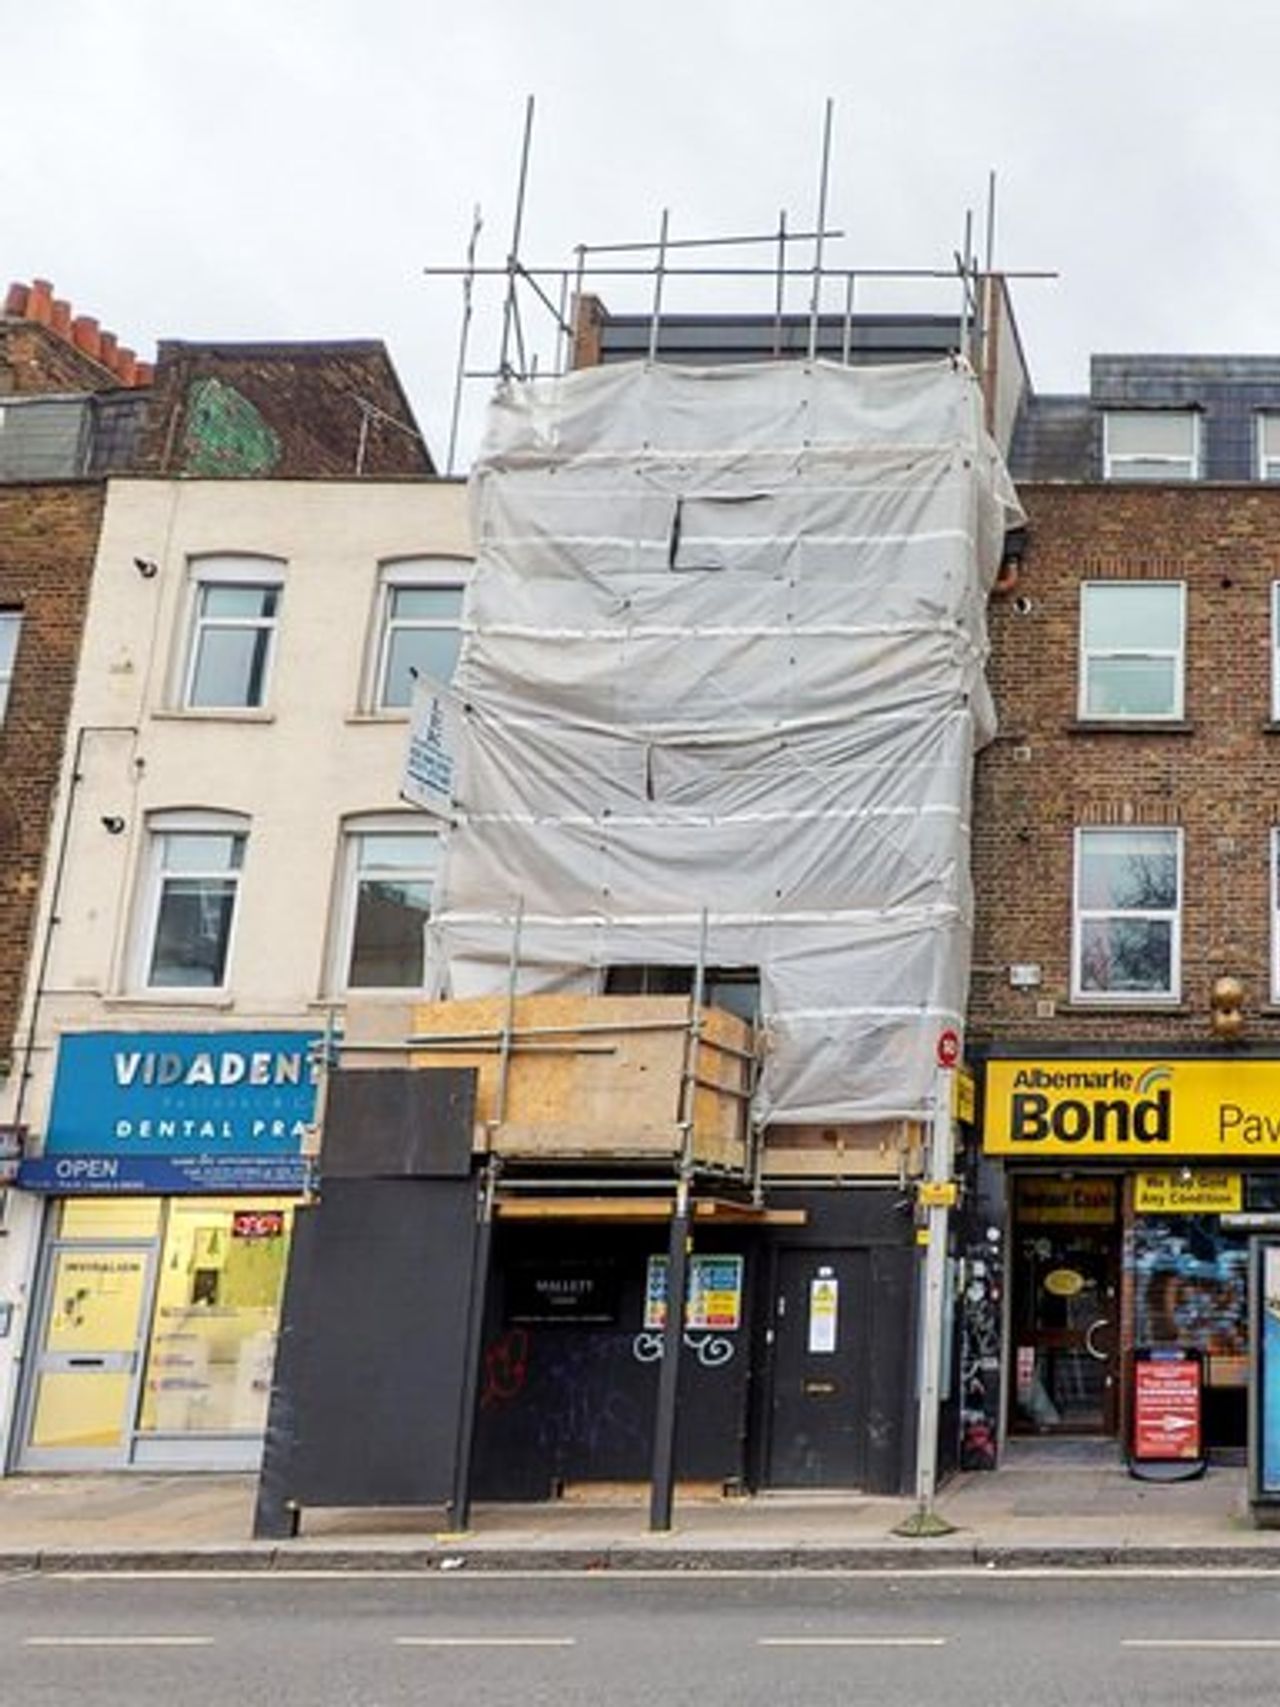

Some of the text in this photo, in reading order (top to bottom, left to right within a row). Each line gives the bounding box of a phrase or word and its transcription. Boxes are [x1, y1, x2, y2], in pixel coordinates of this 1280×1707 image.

[1013, 1068, 1132, 1089] Albemarle
[1011, 1090, 1171, 1142] Bond
[116, 1120, 231, 1138] DENTAL
[56, 1160, 118, 1178] OPEN
[1141, 1193, 1165, 1206] Any
